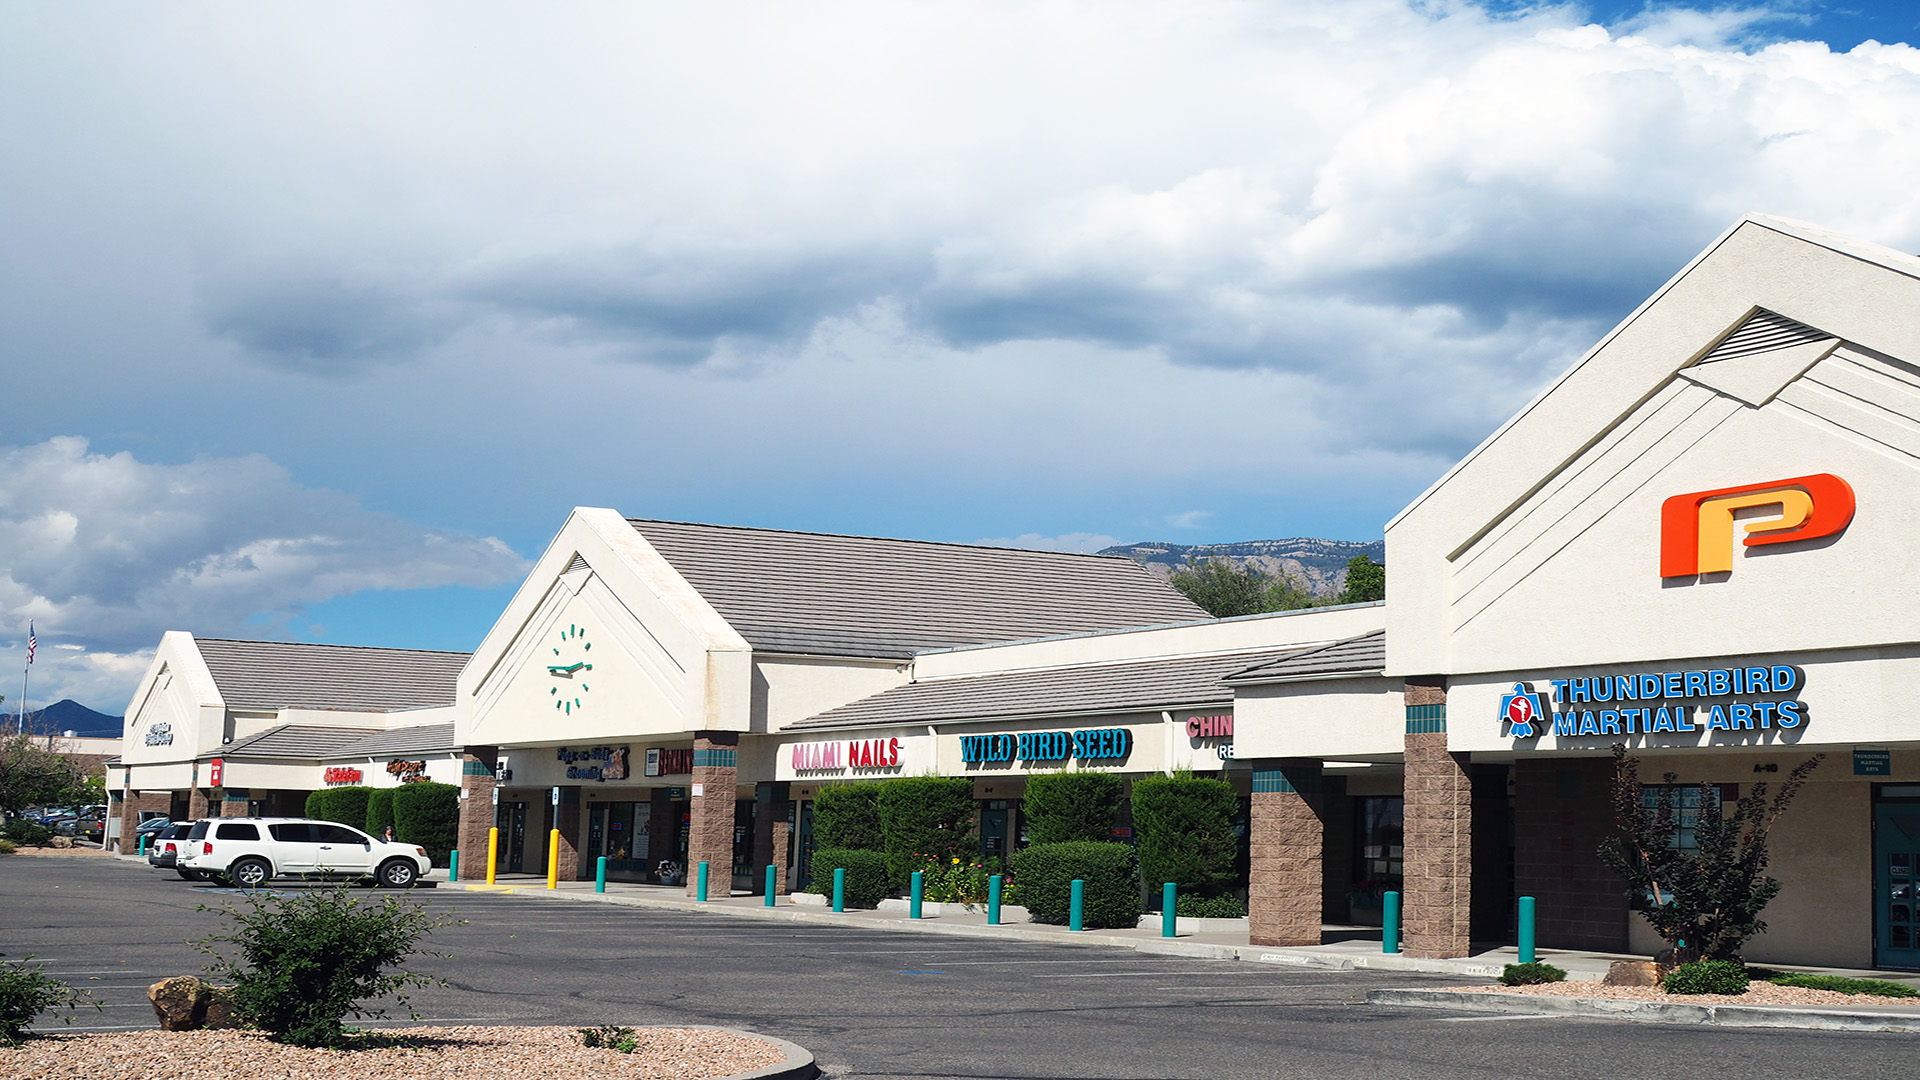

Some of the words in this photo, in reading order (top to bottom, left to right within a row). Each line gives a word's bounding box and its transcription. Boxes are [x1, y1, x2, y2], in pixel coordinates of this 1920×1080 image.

[1550, 664, 1797, 704] THUNDERBIRD
[1552, 706, 1696, 737] MARTIAL
[1706, 700, 1803, 732] ARTS
[792, 741, 841, 769] MIAMI
[848, 737, 899, 767] NAILS
[960, 734, 1012, 762] WILD
[1017, 731, 1068, 761] BIRD
[1073, 728, 1127, 759] SEED
[1753, 764, 1779, 773] A-10
